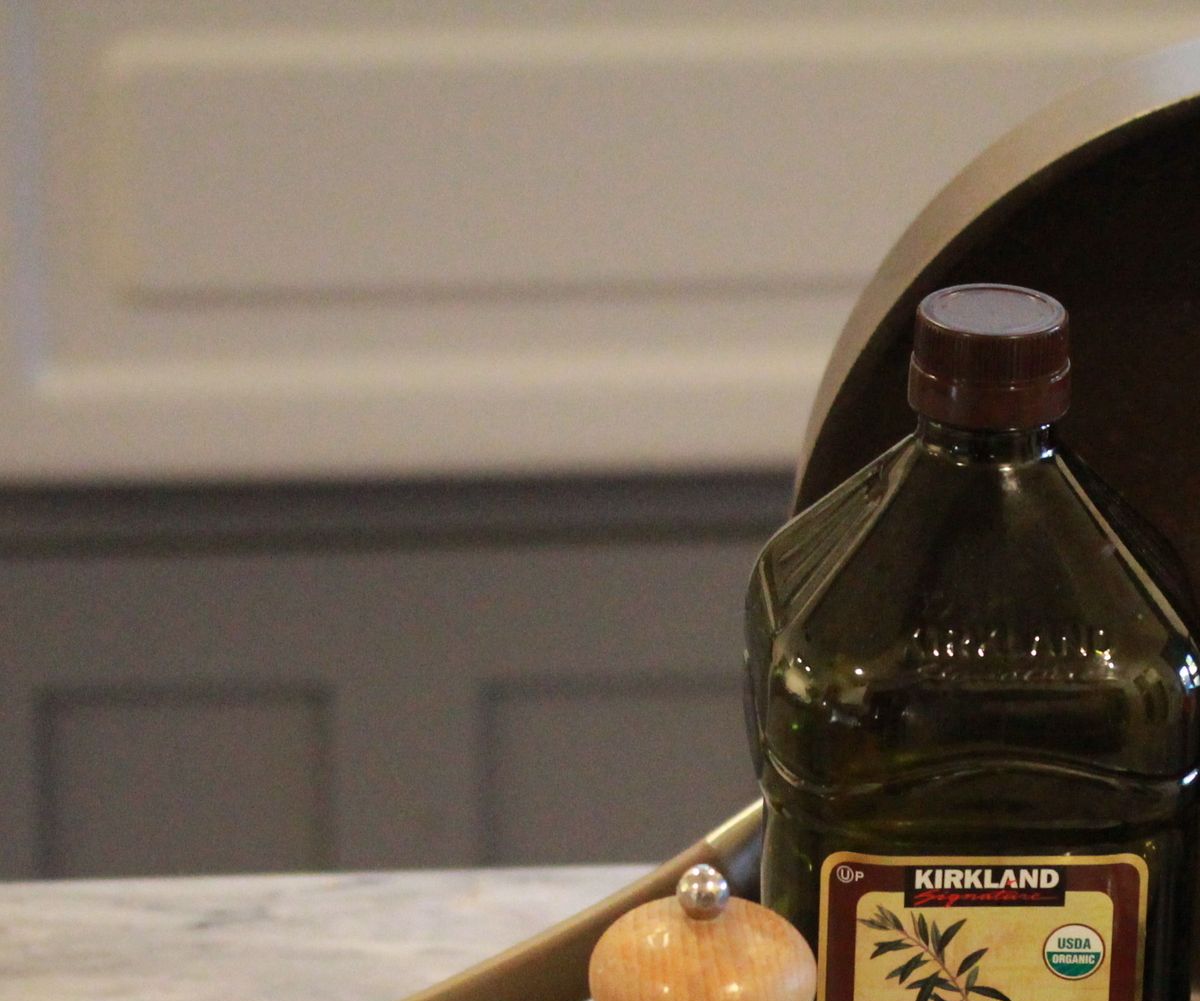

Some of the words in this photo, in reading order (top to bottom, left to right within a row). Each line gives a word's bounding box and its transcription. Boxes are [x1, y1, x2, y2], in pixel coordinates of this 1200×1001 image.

[914, 868, 1060, 889] KIRKLAND
[913, 888, 1057, 908] Signature
[1057, 937, 1091, 950] USDA
[1051, 953, 1096, 965] ORGANIC
